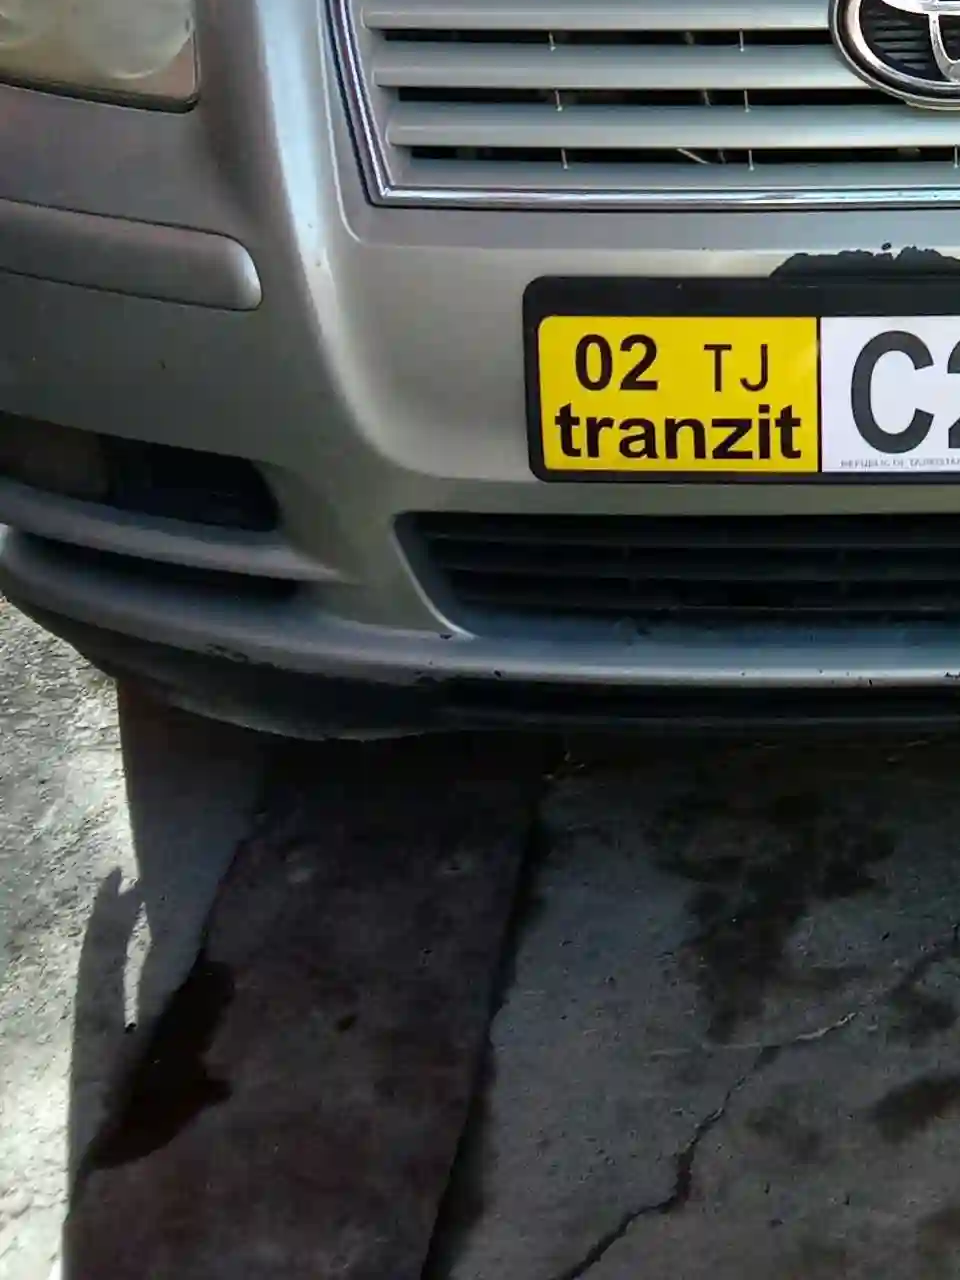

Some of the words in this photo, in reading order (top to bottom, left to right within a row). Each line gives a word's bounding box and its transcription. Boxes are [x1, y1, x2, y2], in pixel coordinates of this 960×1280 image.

[574, 333, 659, 392] 02
[703, 343, 769, 393] TJ
[554, 402, 802, 460] tranzit
